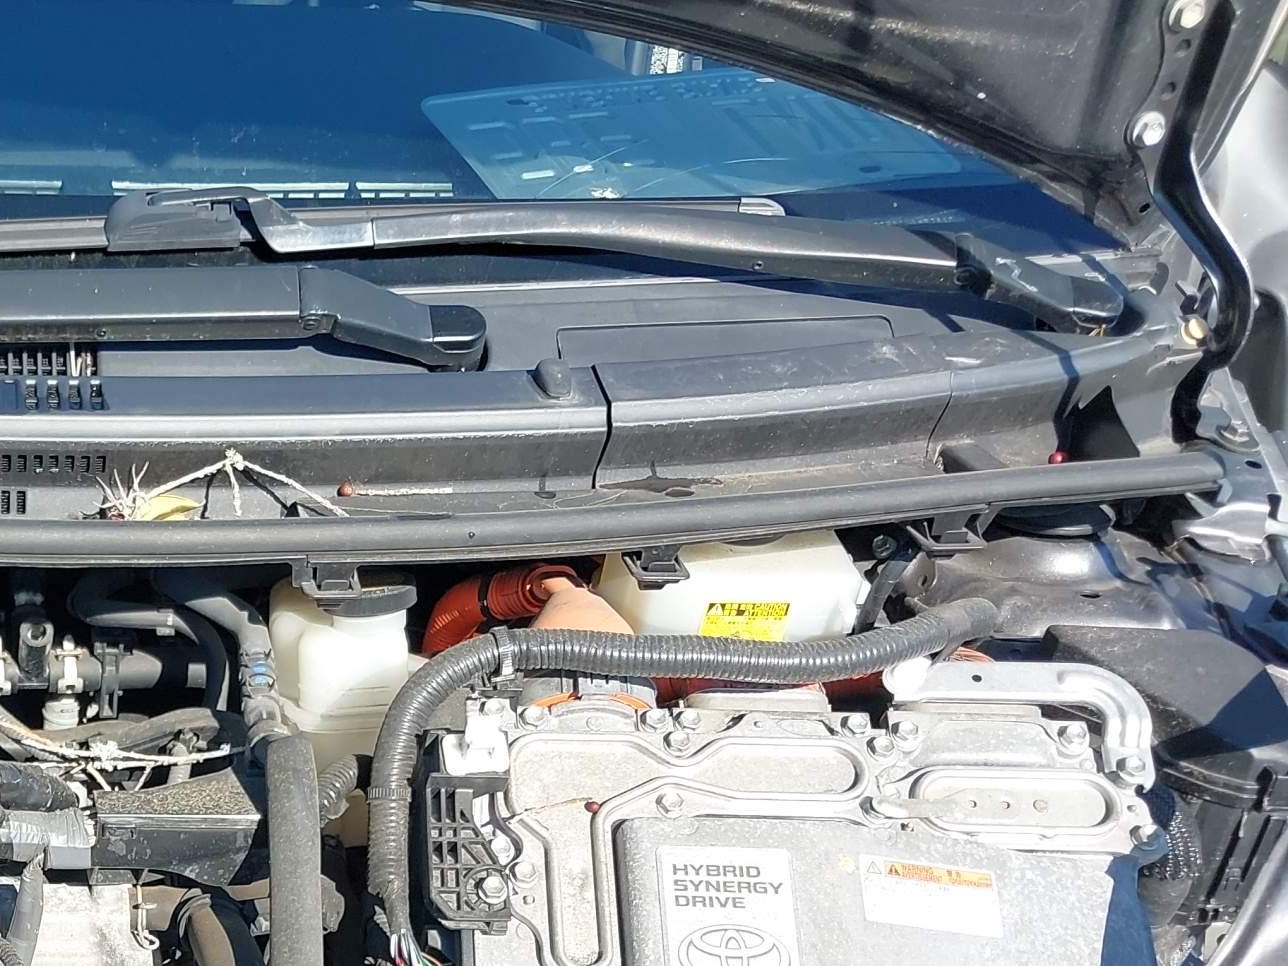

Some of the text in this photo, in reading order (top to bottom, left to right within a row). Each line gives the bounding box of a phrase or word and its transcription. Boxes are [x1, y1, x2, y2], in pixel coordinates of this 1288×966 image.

[672, 863, 761, 878] HYBRID
[673, 879, 783, 895] SYNERGY
[675, 895, 746, 909] DRIVE
